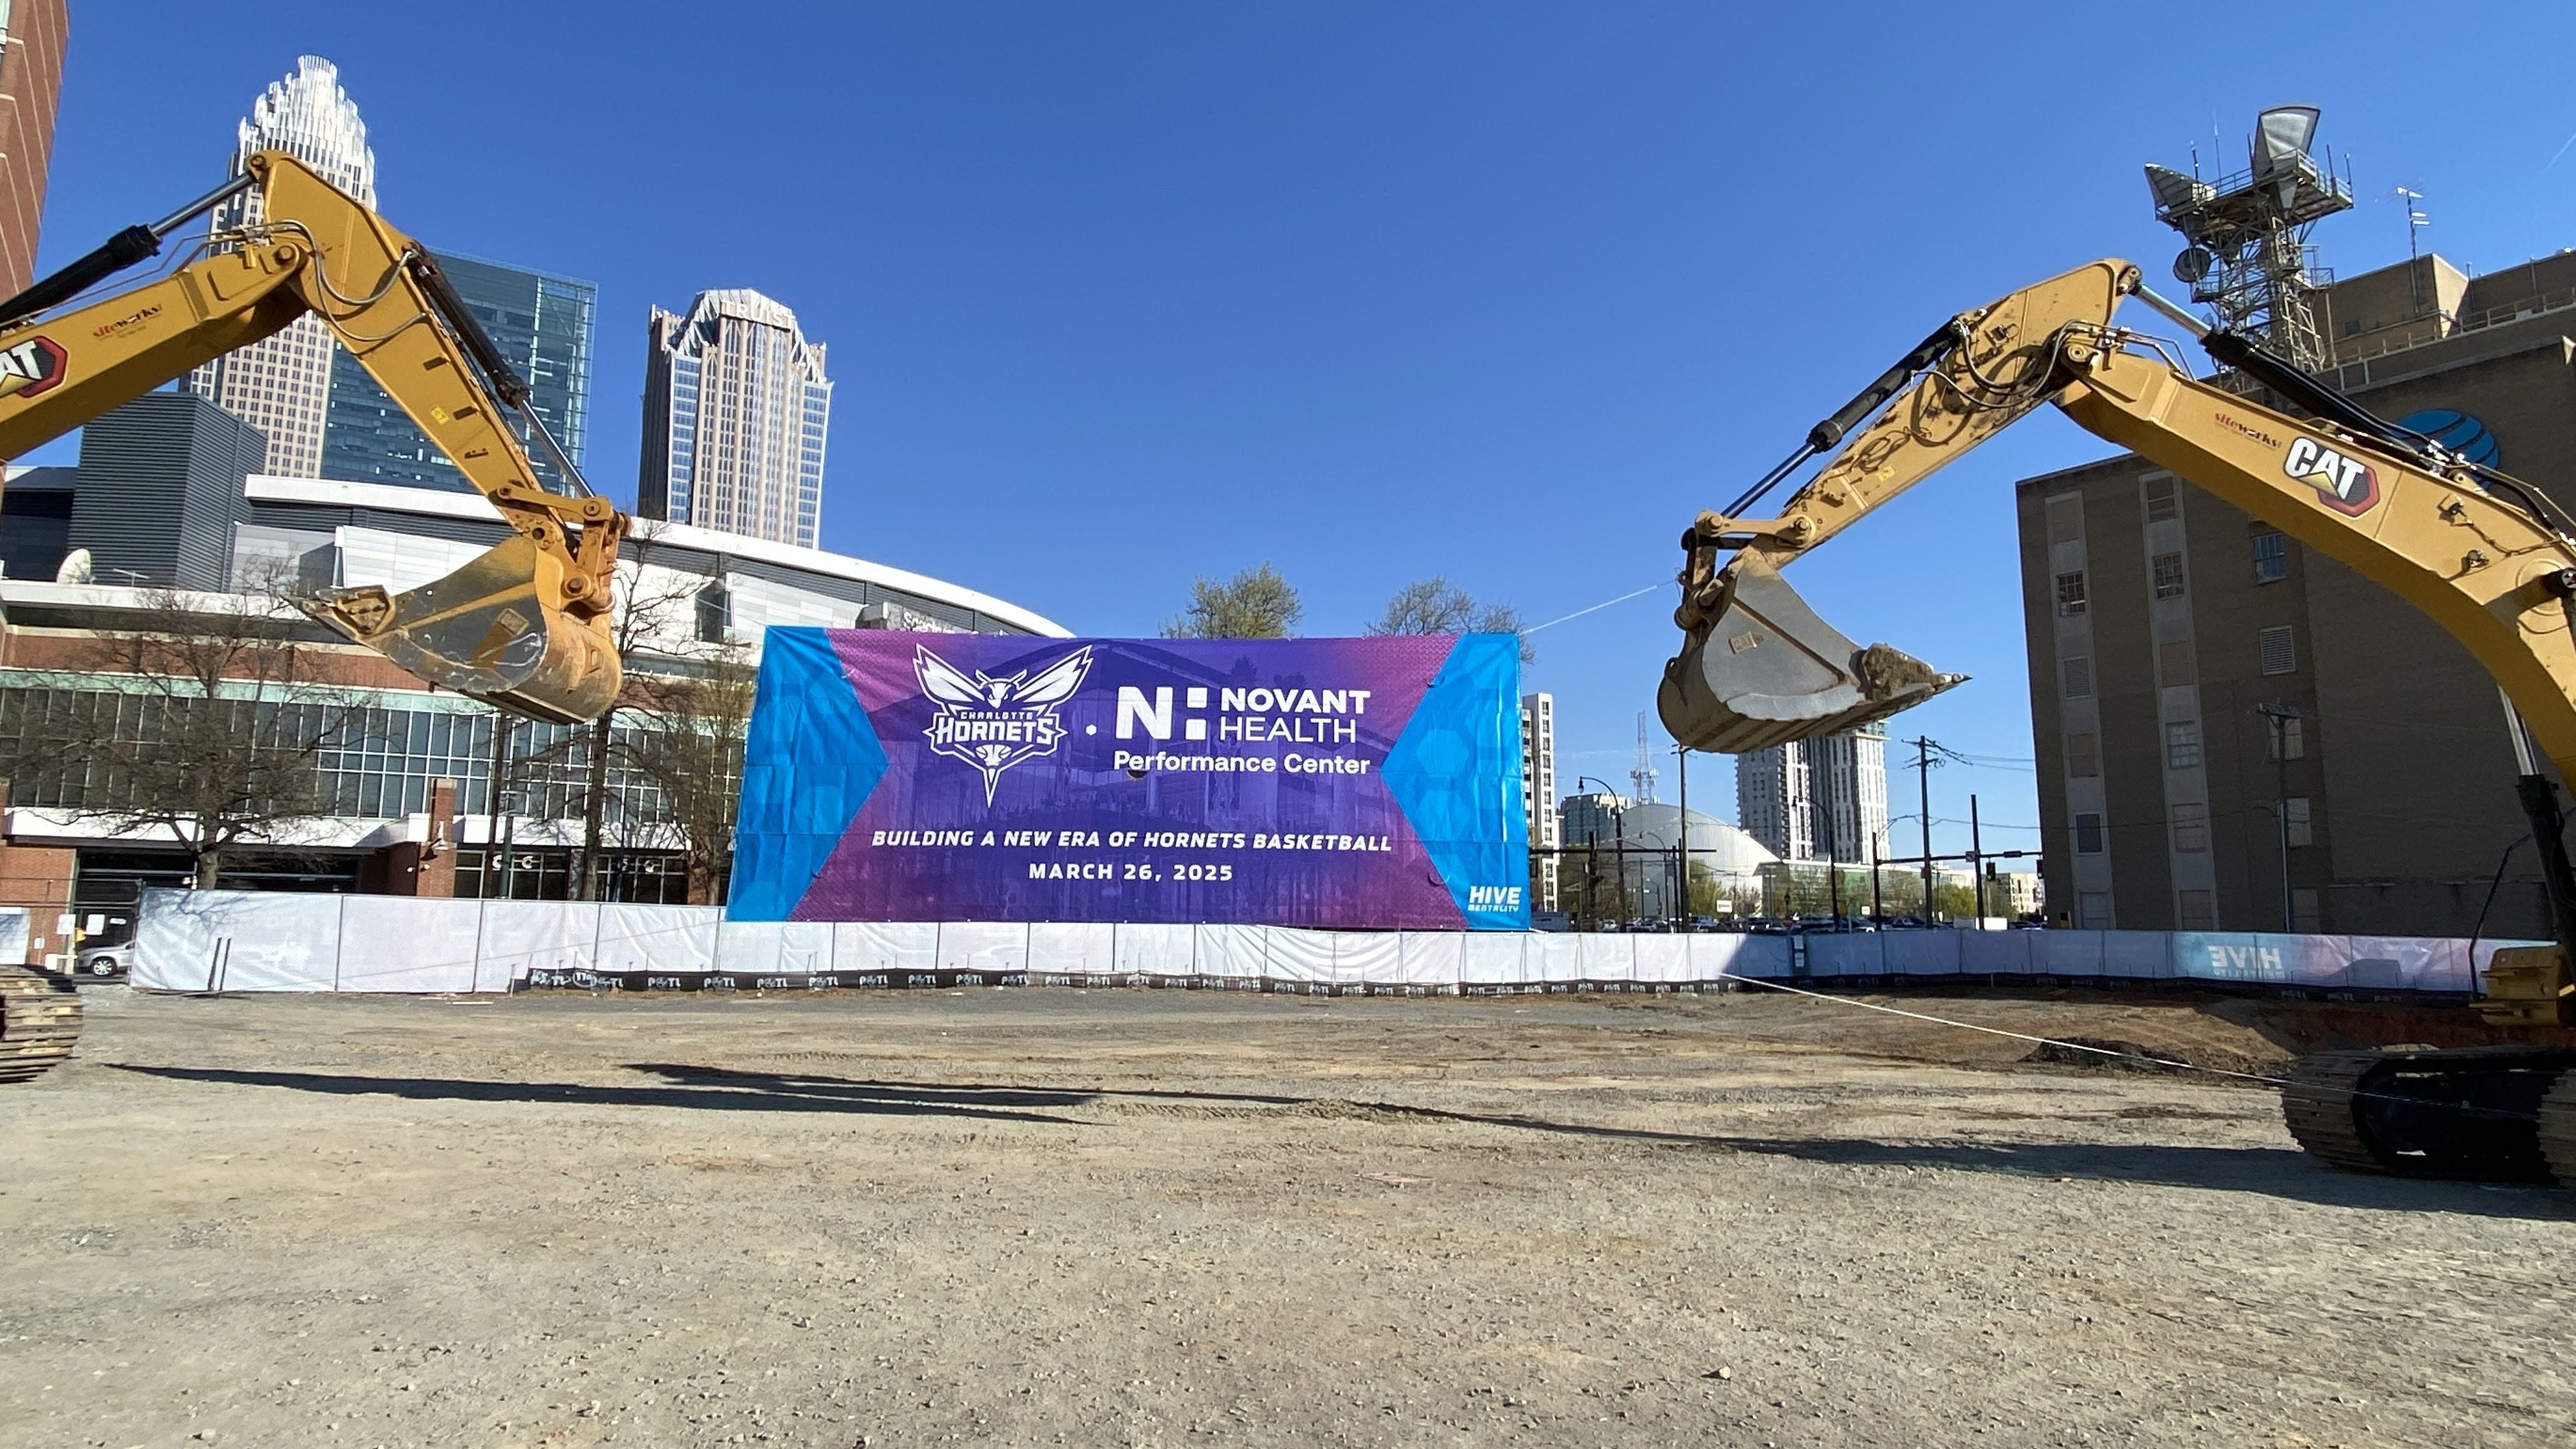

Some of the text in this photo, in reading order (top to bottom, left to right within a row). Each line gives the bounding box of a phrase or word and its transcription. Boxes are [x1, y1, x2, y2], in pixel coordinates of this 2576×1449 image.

[0, 341, 42, 386] AT
[2285, 438, 2365, 500] CAT
[1220, 687, 1371, 714] NOVANT
[960, 712, 1033, 720] CHARLOTTE
[935, 717, 1056, 745] HORNETS
[1220, 716, 1356, 744] HEALTH
[1114, 750, 1371, 775] Performance Center
[871, 831, 1392, 852] BUILDING A NEW ERA OF HORNETS BASKETBALL
[1029, 863, 1233, 882] MARCH 26, 2025
[1469, 885, 1522, 904] HIVE
